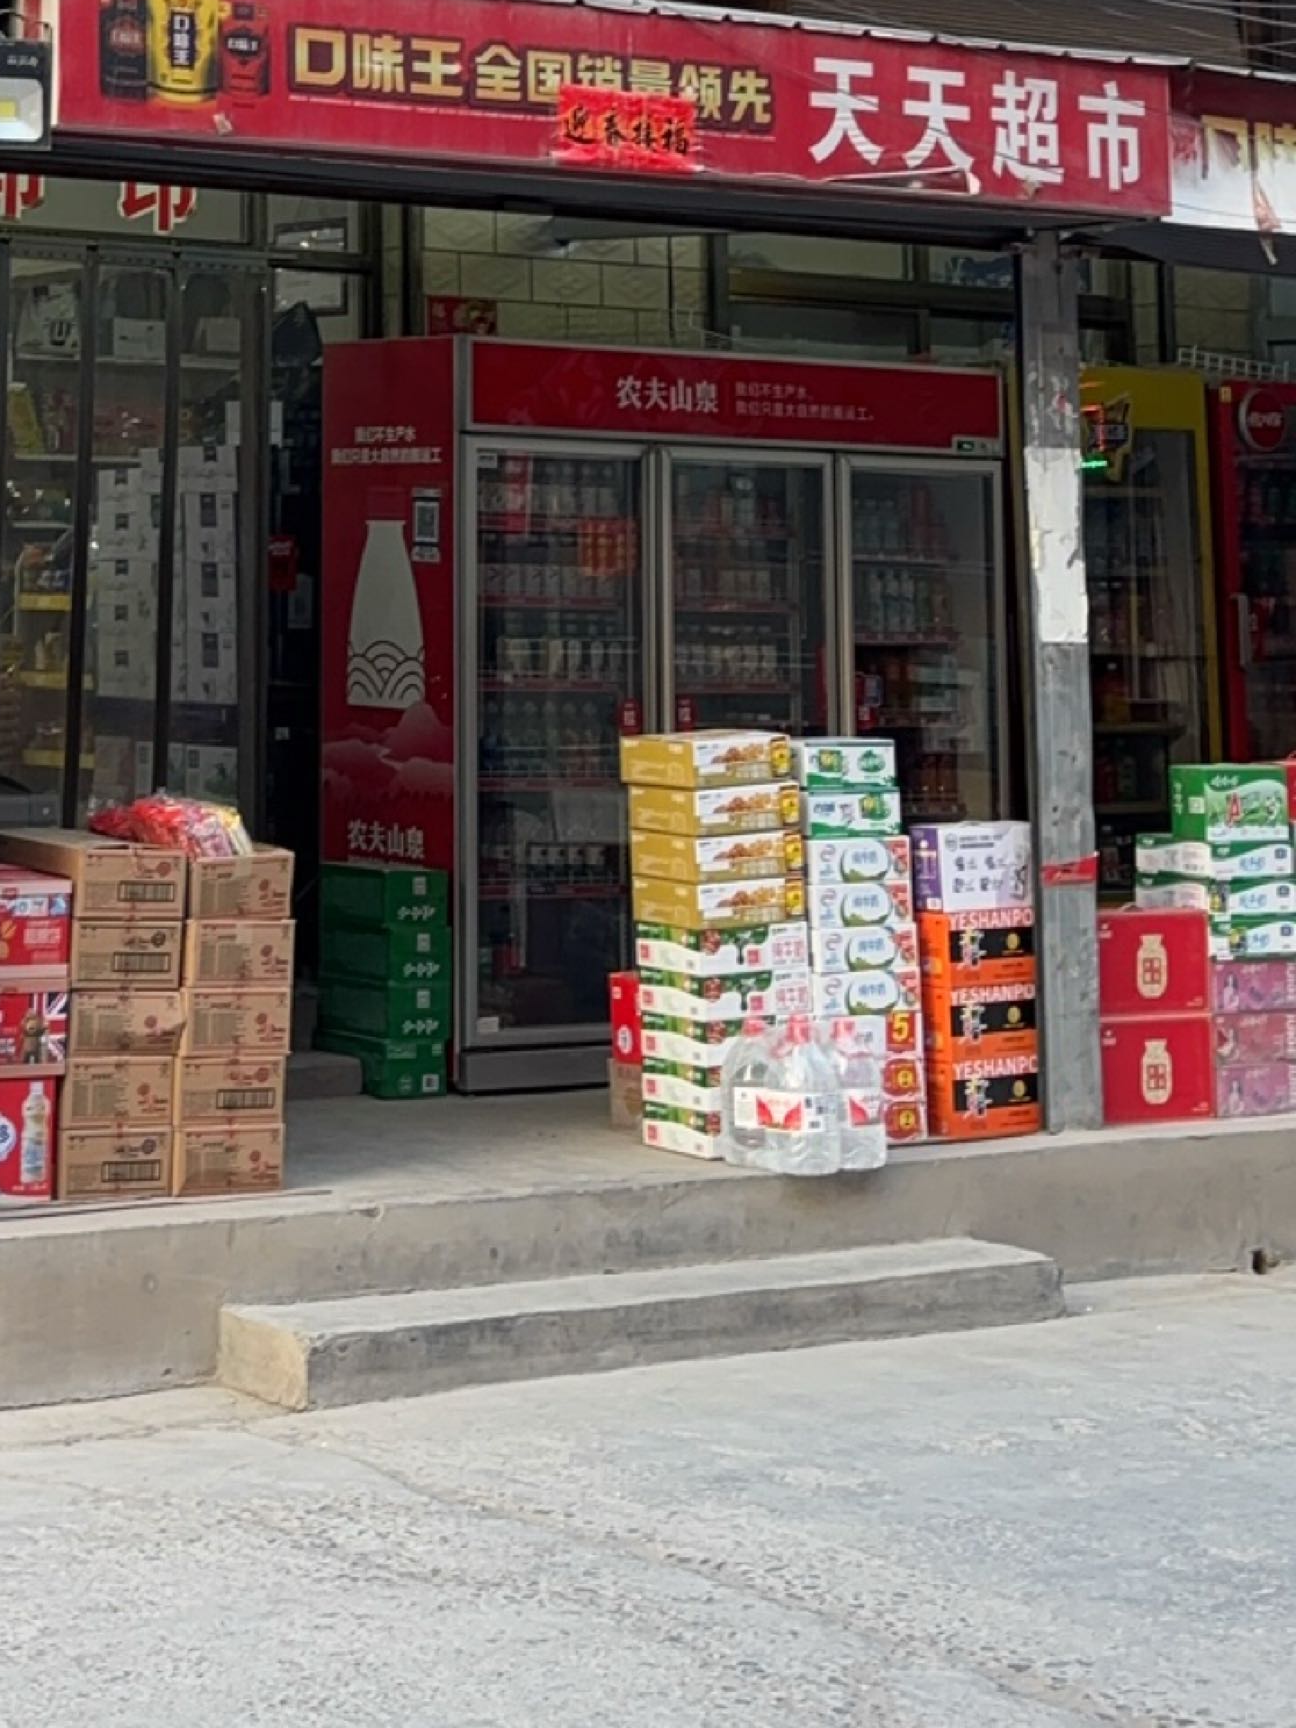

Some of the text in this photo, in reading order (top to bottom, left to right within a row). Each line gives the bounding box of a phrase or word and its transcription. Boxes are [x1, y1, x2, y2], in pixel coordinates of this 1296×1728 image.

[809, 57, 1146, 191] 天天超市
[616, 375, 719, 414] 农夫山泉
[347, 819, 425, 860] 农夫山泉
